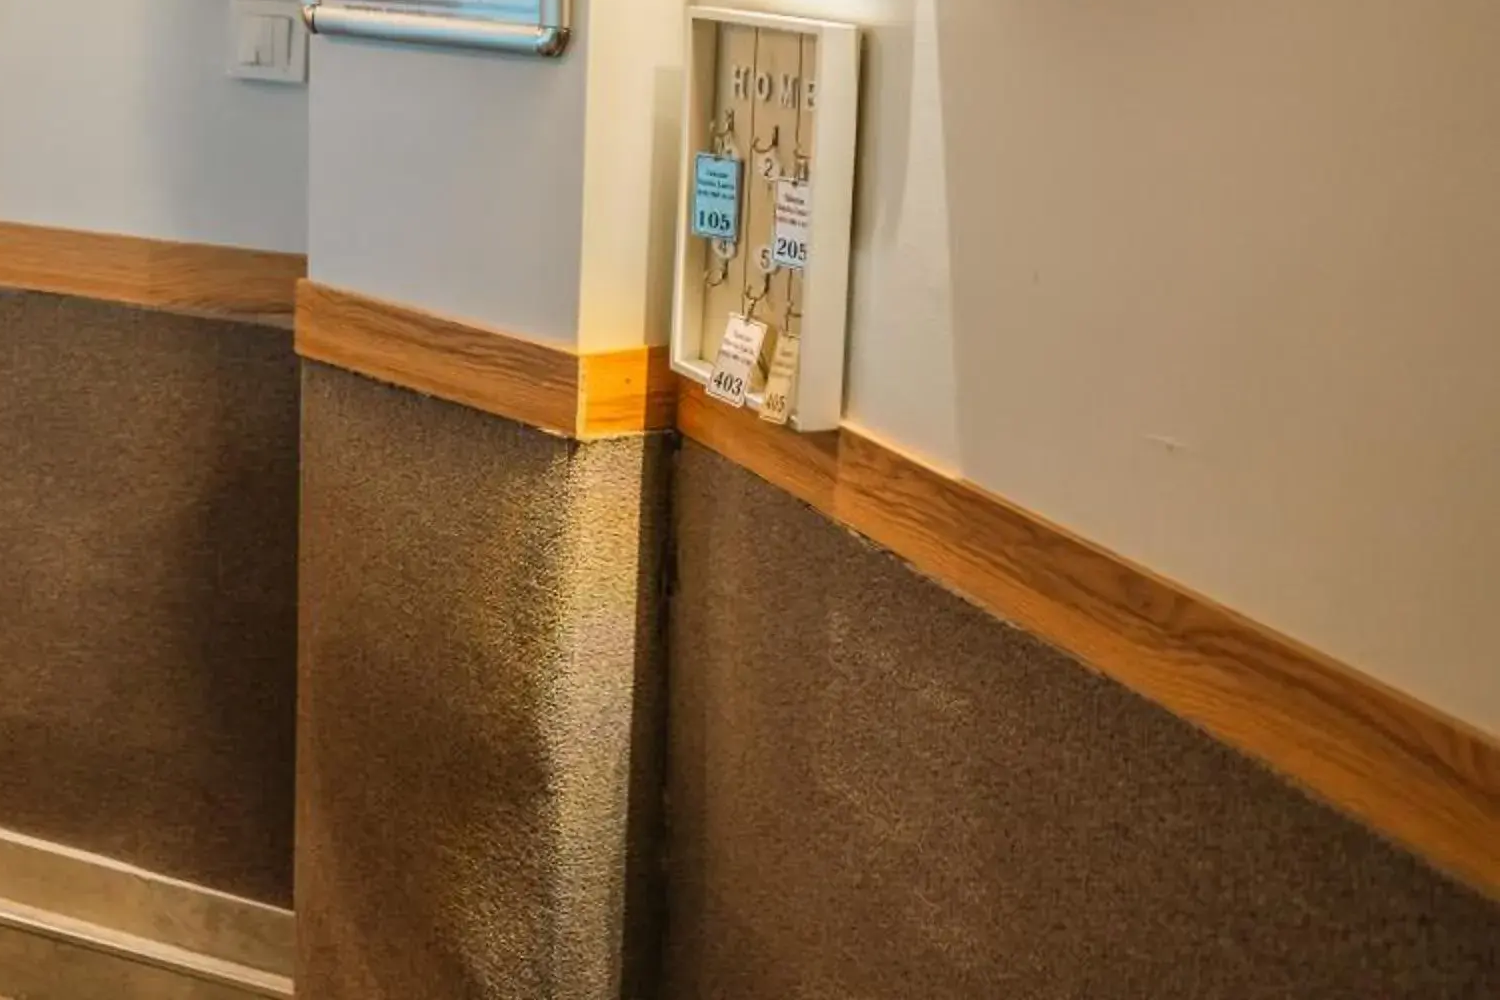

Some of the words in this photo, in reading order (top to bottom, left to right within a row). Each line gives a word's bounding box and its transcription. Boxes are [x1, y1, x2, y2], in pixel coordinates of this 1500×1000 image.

[699, 209, 731, 231] 105
[776, 237, 807, 262] 205
[713, 371, 743, 397] 403
